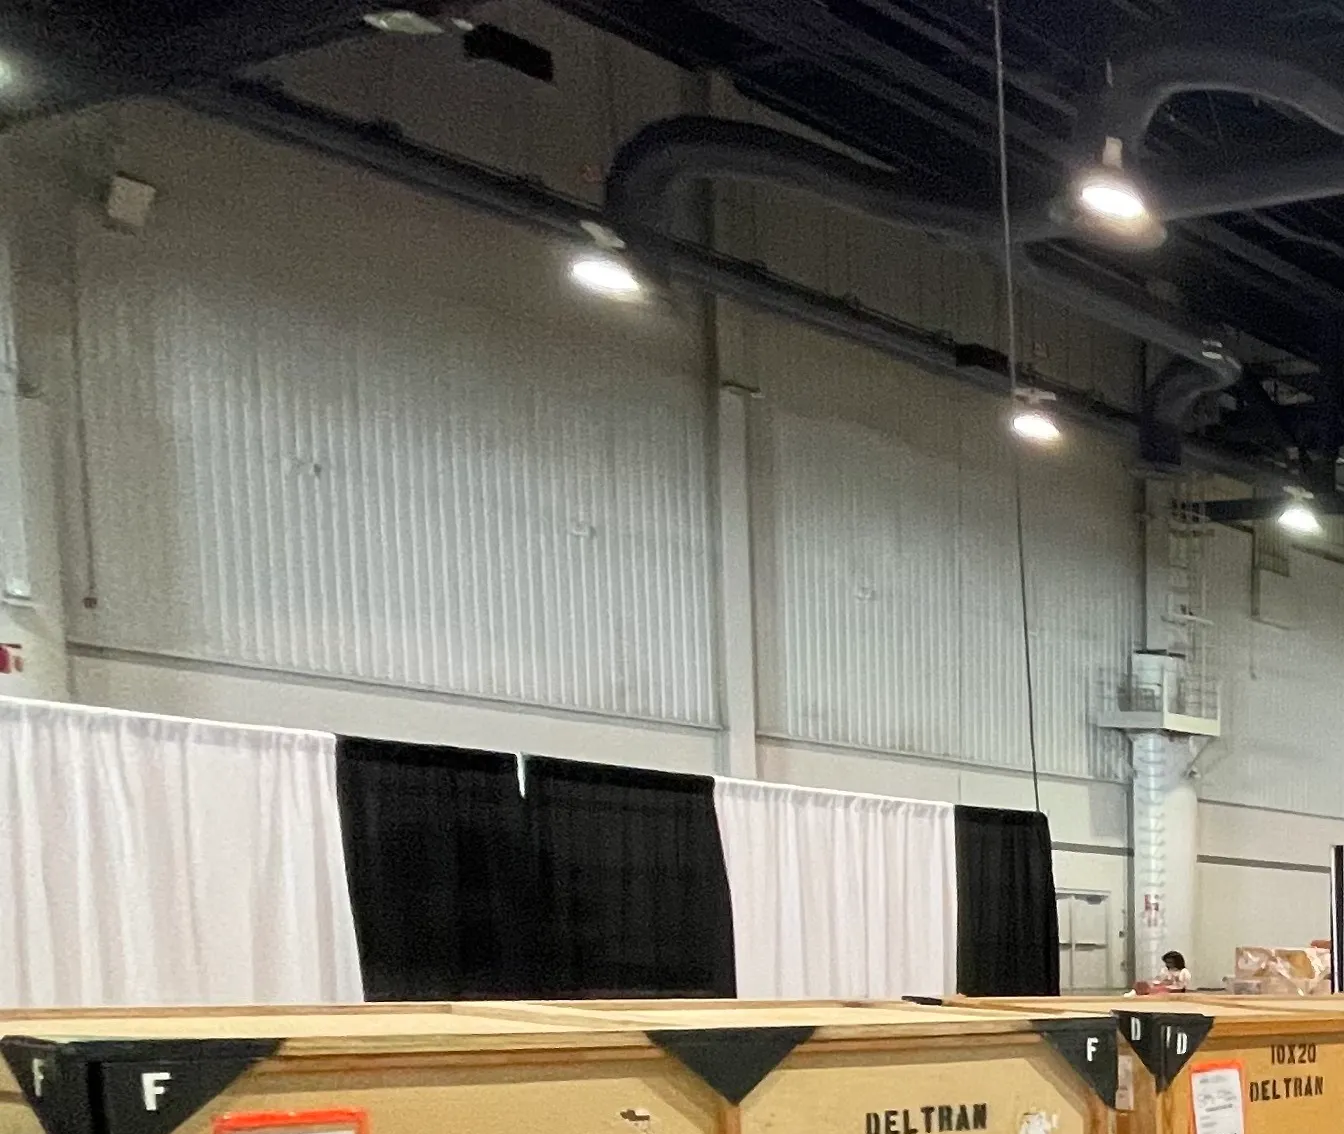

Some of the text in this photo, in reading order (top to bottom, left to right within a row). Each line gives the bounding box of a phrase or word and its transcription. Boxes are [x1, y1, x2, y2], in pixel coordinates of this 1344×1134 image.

[1130, 1016, 1141, 1041] D
[1086, 1037, 1099, 1062] F
[1176, 1032, 1188, 1055] D
[1270, 1043, 1317, 1065] 10X20
[32, 1058, 45, 1098] F
[1249, 1076, 1324, 1103] DELTRAN
[141, 1072, 172, 1111] F
